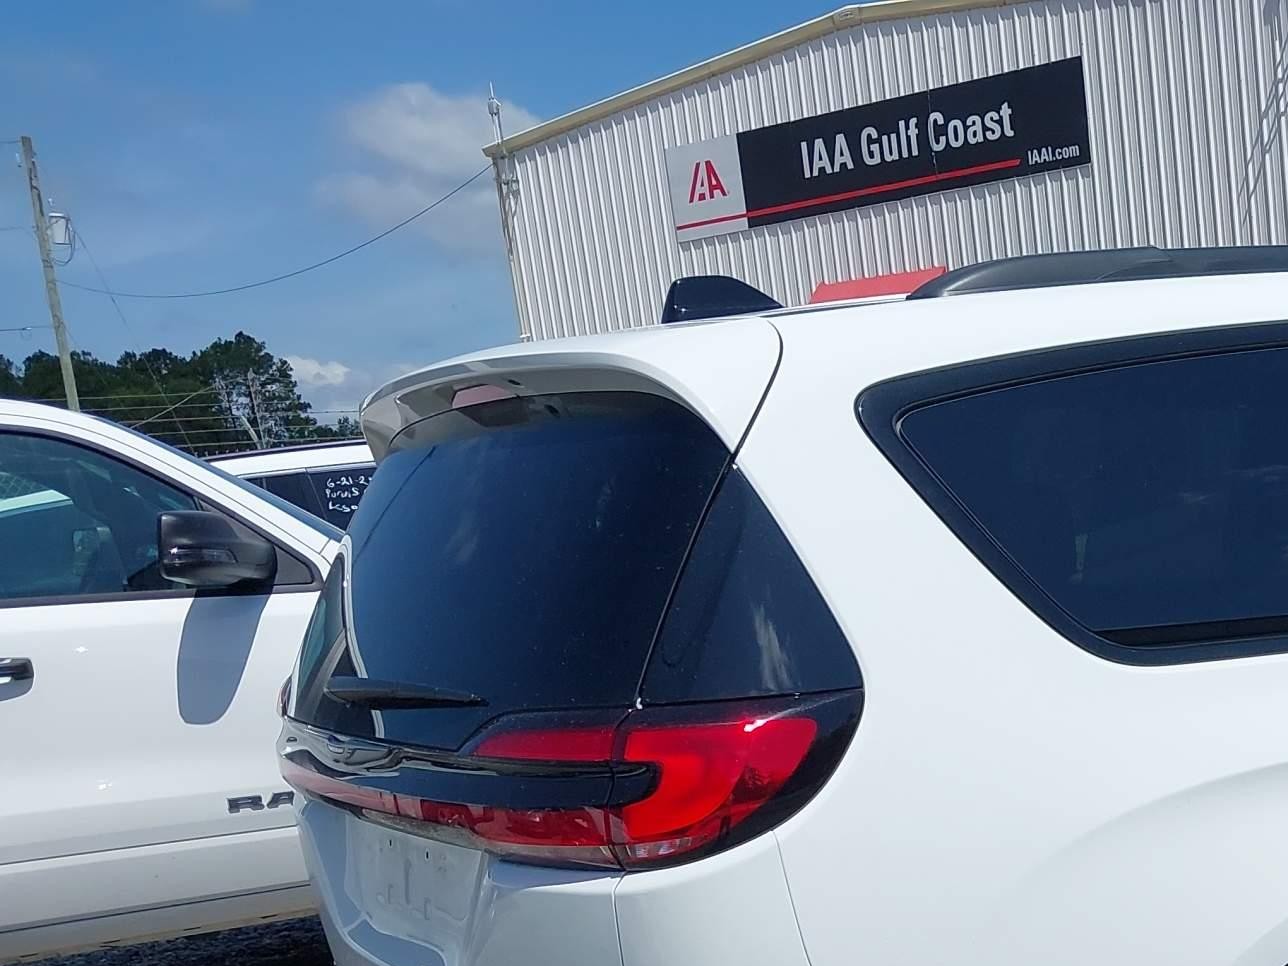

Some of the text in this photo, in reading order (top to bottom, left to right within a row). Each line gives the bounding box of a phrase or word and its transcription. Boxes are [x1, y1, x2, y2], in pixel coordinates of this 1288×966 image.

[801, 101, 1015, 179] IAA Gulf Coast
[1027, 144, 1080, 166] IAAI.com
[326, 475, 372, 488] 6-21-2
[227, 790, 295, 814] RA
